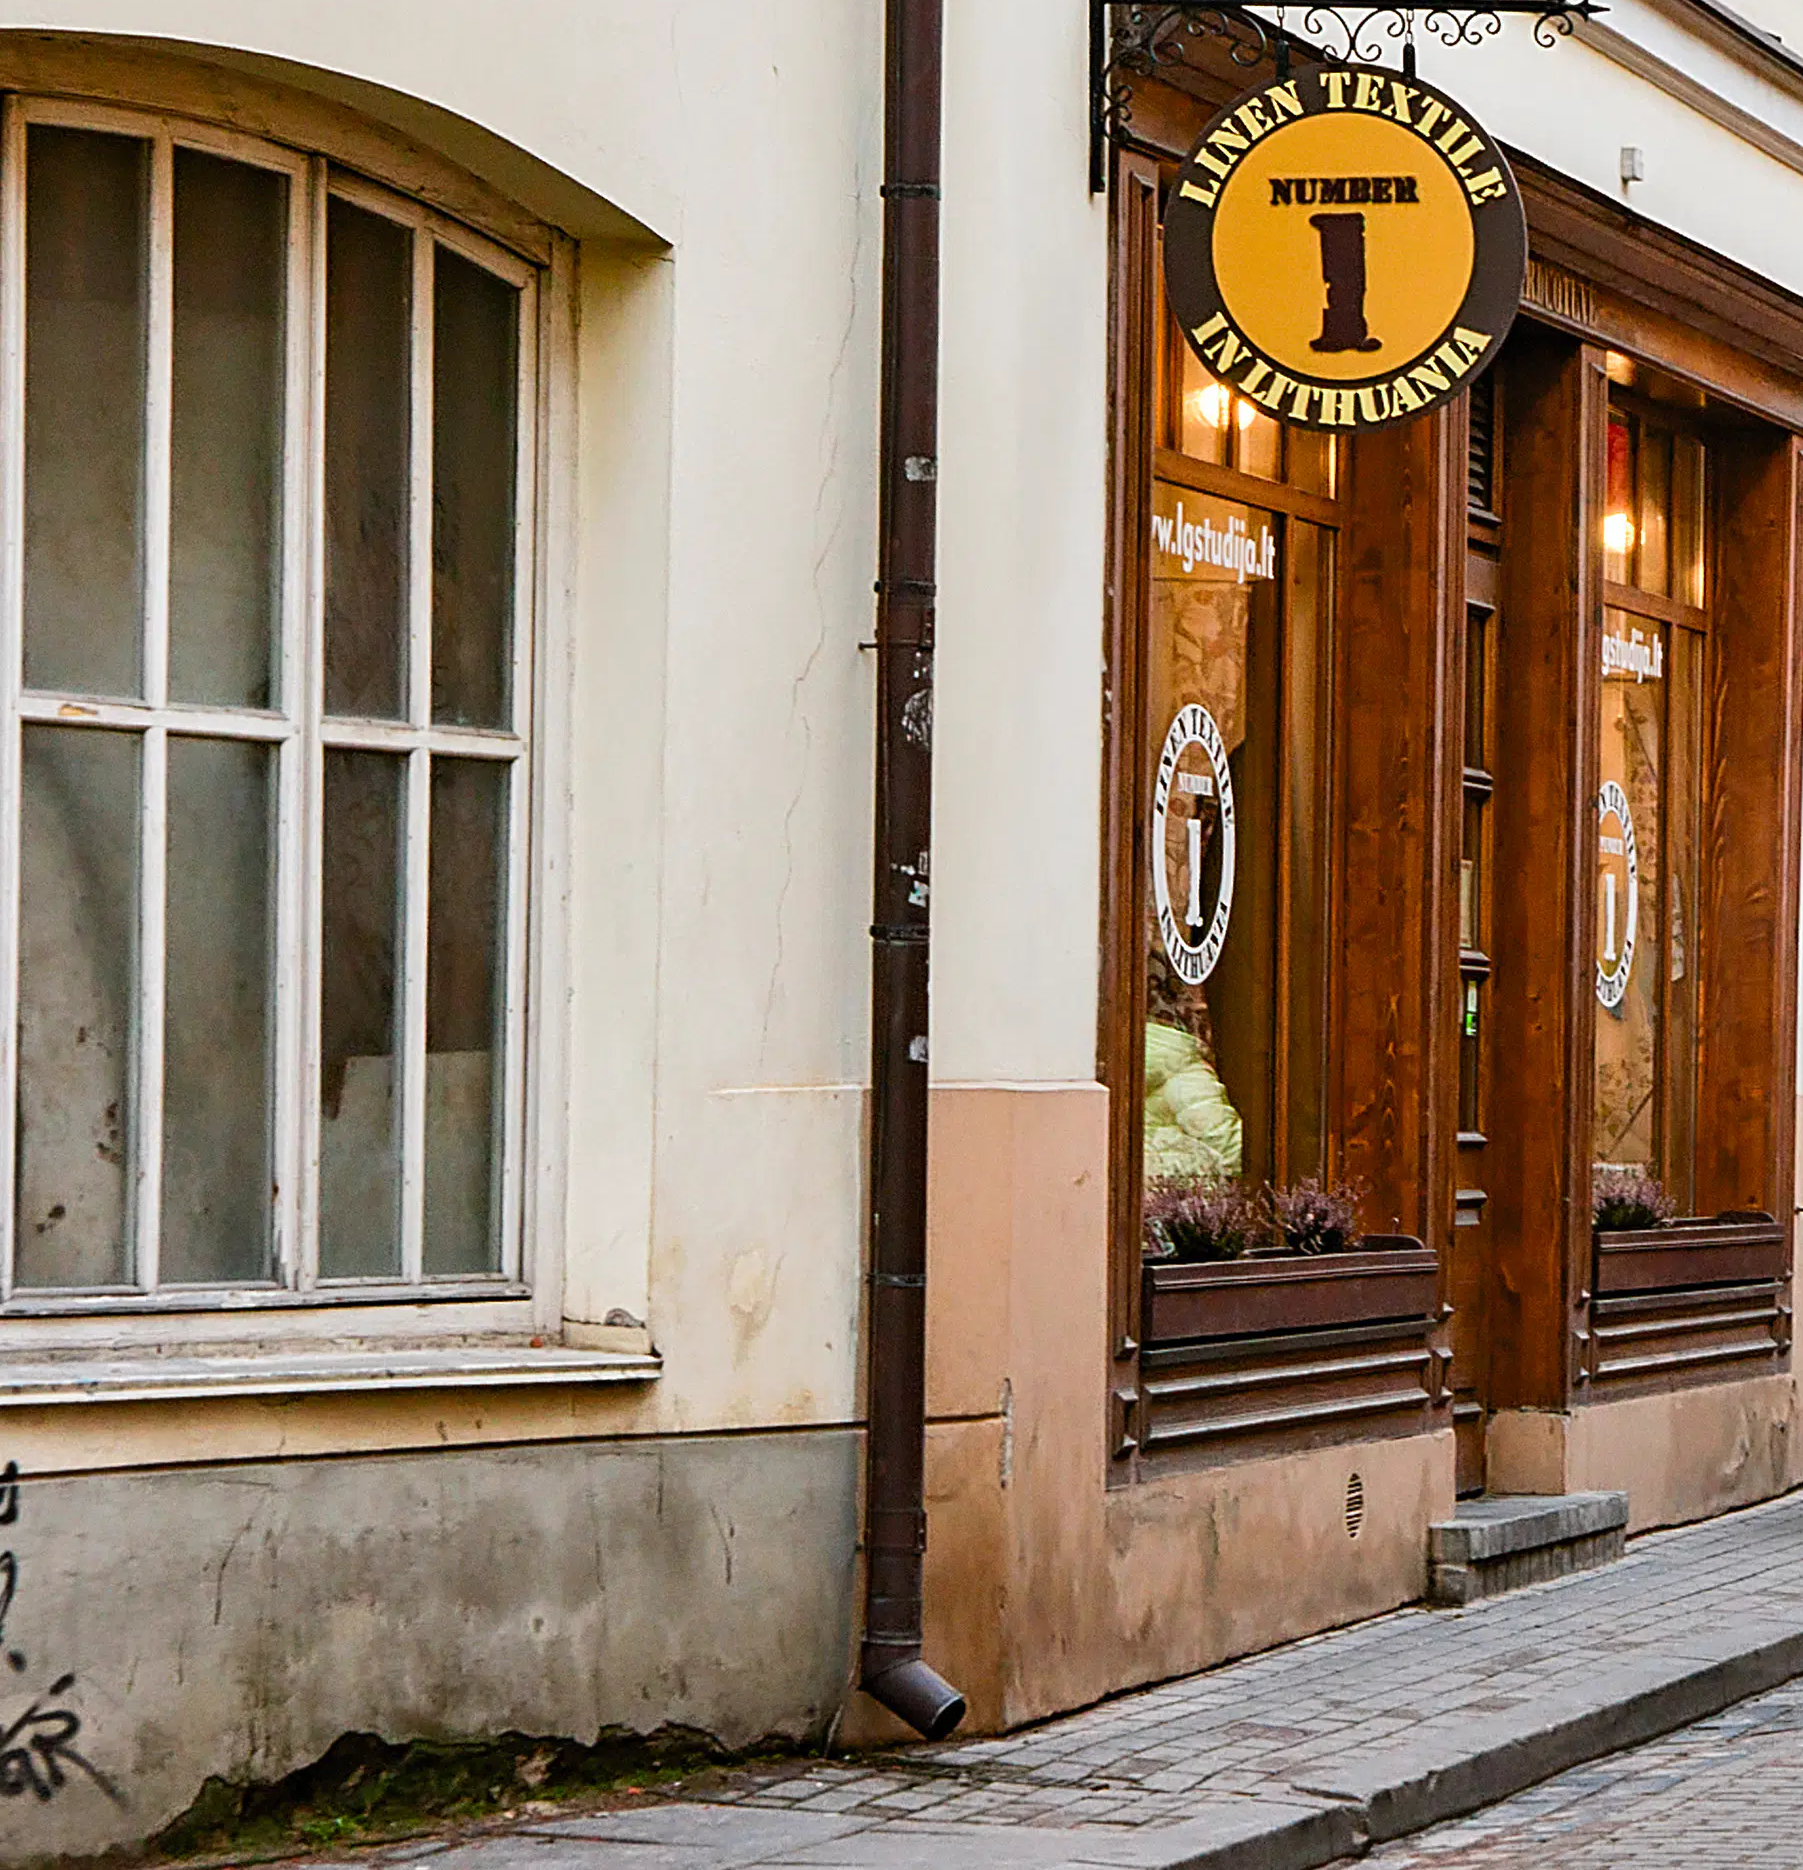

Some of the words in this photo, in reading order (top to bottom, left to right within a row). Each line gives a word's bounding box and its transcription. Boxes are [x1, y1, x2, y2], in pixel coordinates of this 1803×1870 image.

[1179, 80, 1303, 209] LINEN
[1320, 71, 1507, 206] TEXTILE
[1269, 176, 1420, 206] NUMBER
[1309, 212, 1383, 353] 1
[1191, 311, 1246, 374] IN
[1243, 327, 1493, 427] LITHUANIA
